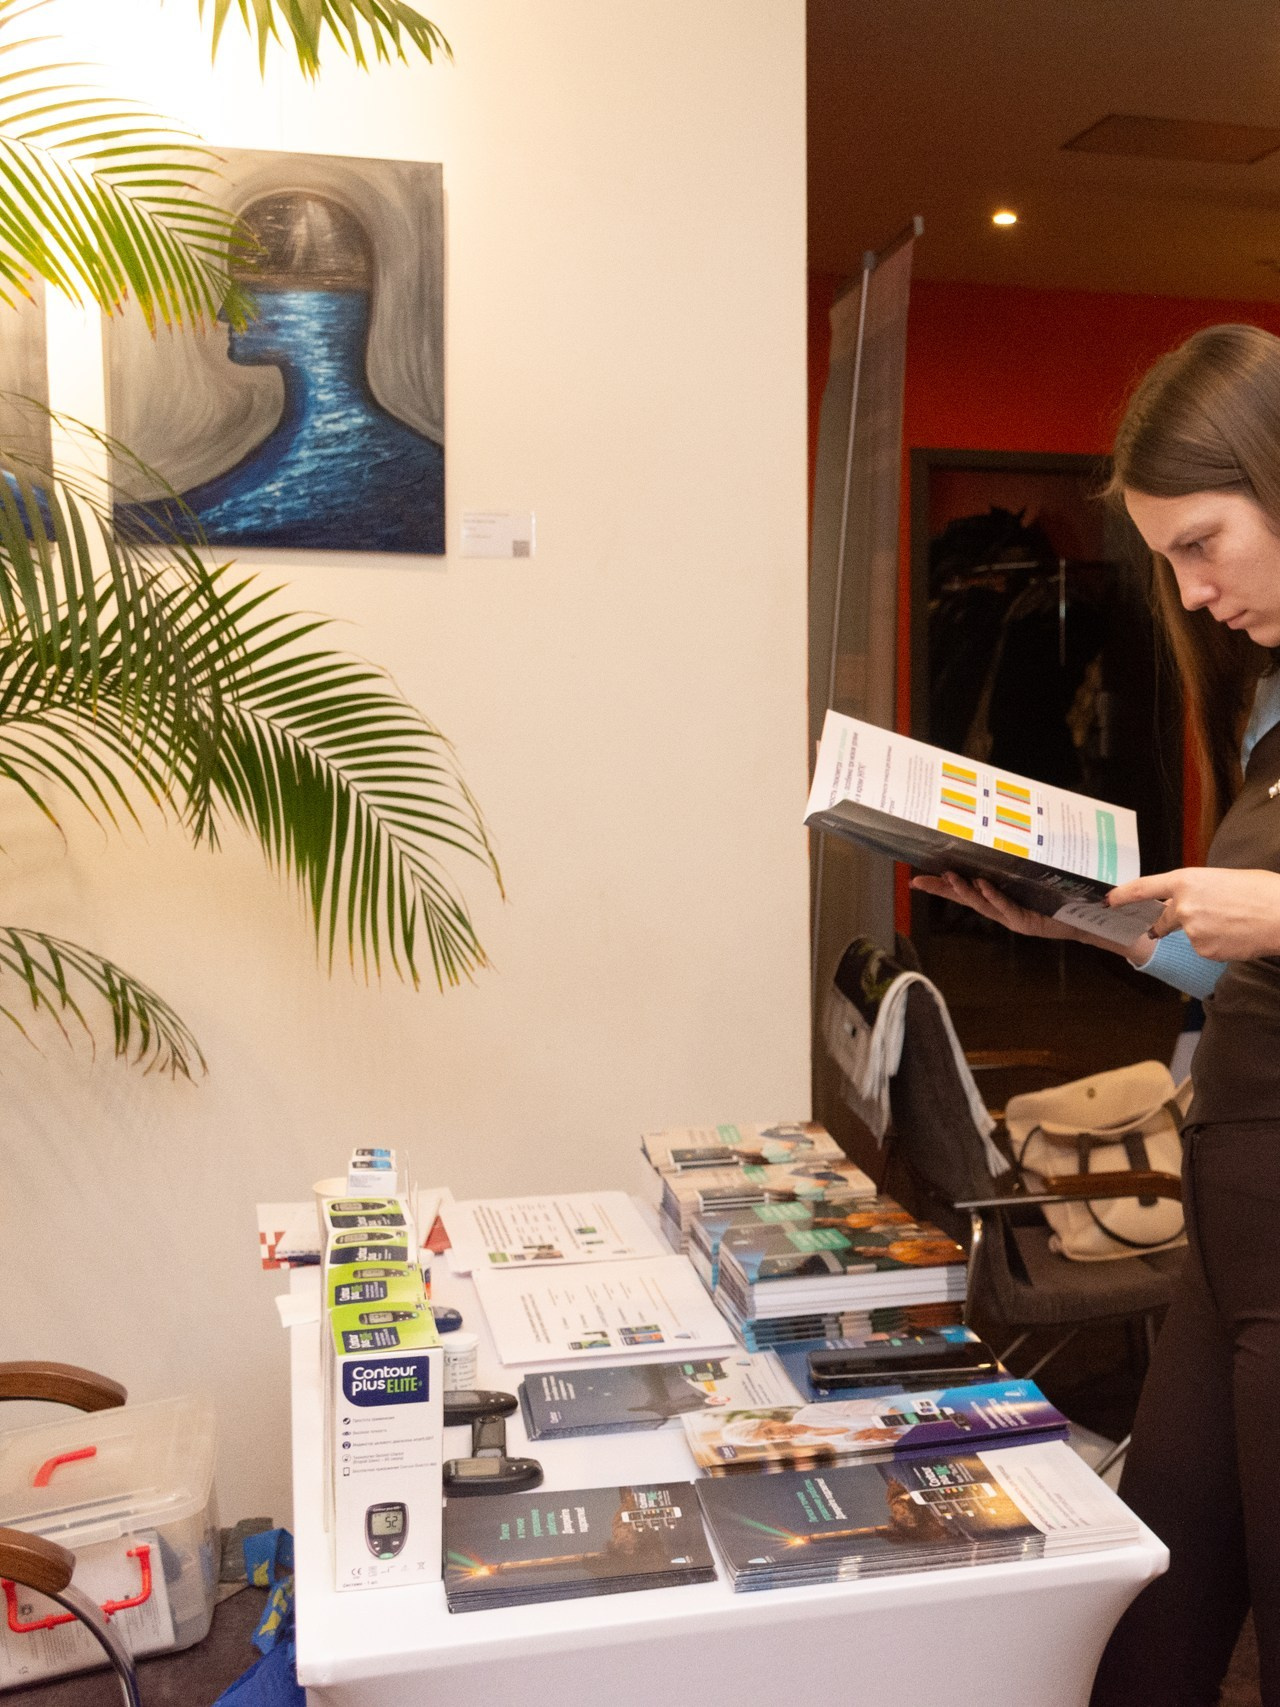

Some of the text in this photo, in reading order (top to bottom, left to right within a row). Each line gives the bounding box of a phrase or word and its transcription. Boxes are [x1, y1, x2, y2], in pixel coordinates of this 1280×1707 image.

[352, 1365, 417, 1380] Contour
[351, 1377, 418, 1397] plus ELITE
